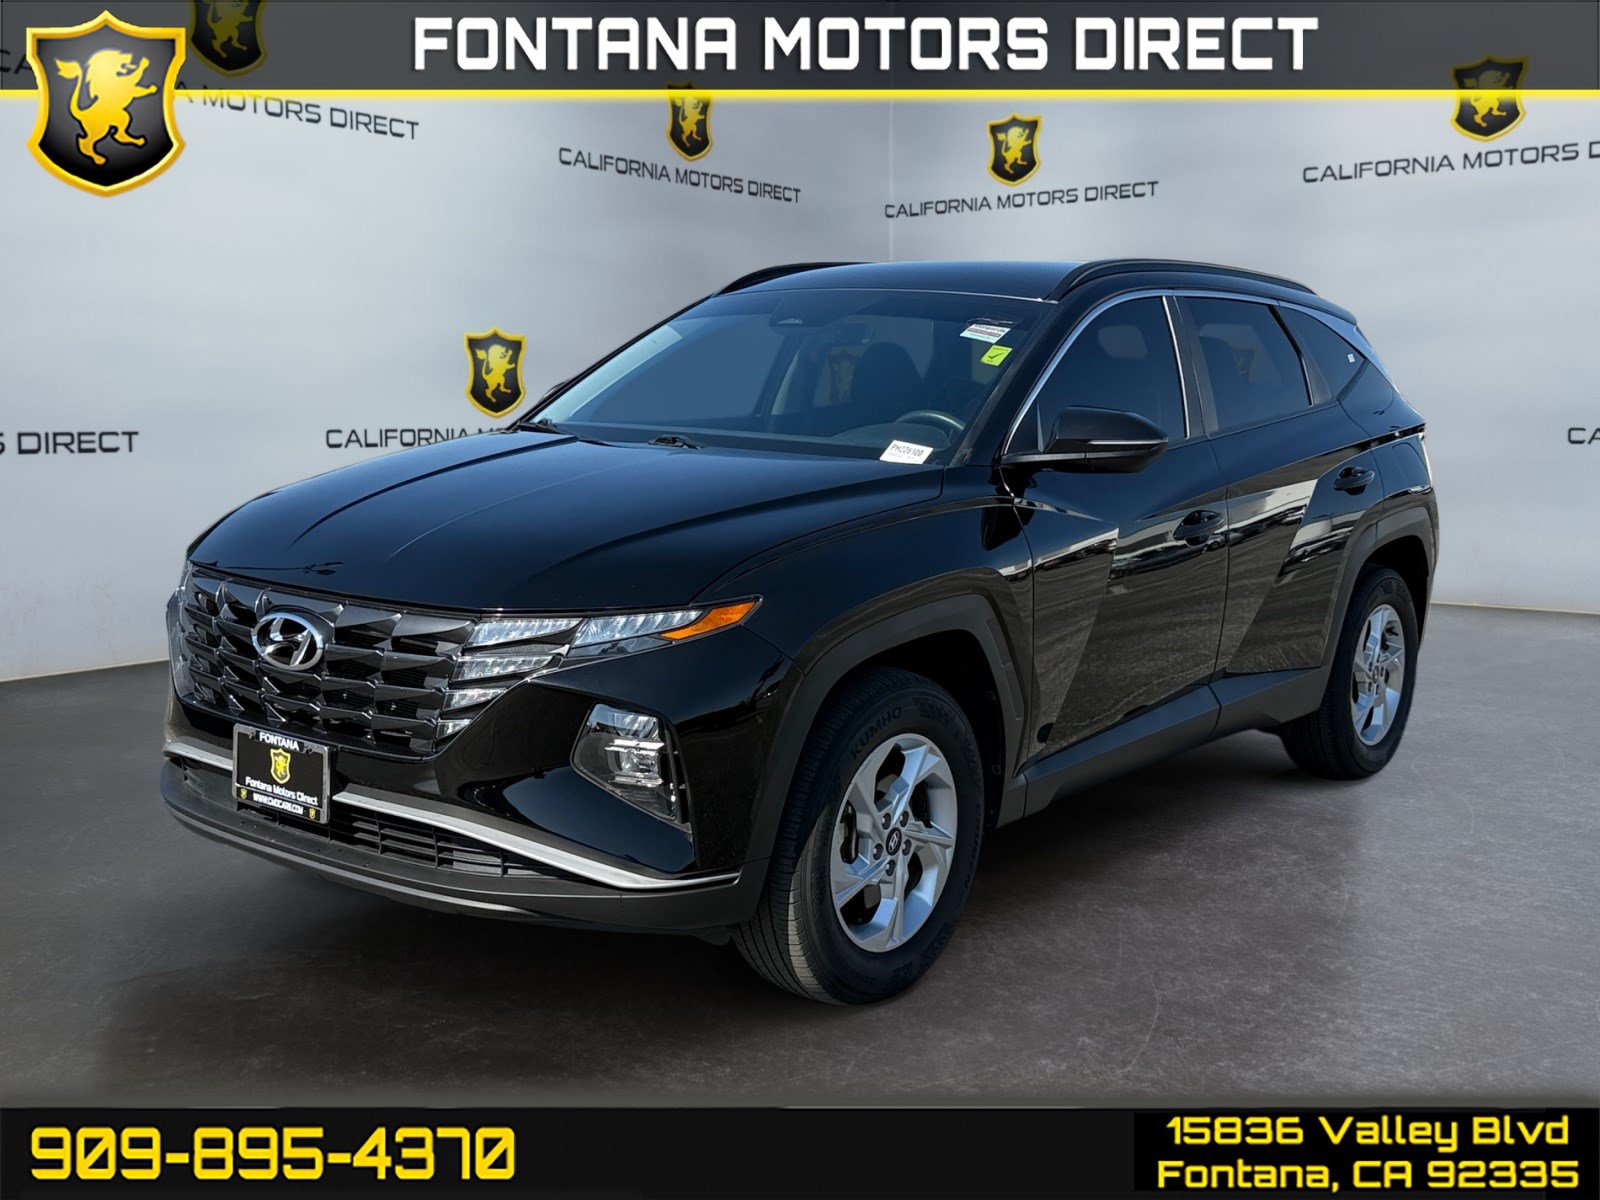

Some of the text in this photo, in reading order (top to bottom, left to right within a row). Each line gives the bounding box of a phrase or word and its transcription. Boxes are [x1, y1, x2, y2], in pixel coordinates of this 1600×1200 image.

[203, 84, 322, 124] MOTORS
[329, 107, 420, 140] DIRECT
[559, 147, 802, 203] CALIFORNIA MOTORS DIRECT
[1302, 155, 1455, 183] CALIFORNIA
[1463, 143, 1579, 169] MOTORS
[884, 181, 1159, 219] CALIFORNIA MOTORS DIRECT
[17, 431, 139, 455] DIRECT
[259, 731, 299, 751] FONTANA
[850, 706, 902, 759] KUMHO
[245, 776, 319, 806] Fontana Motors Direct
